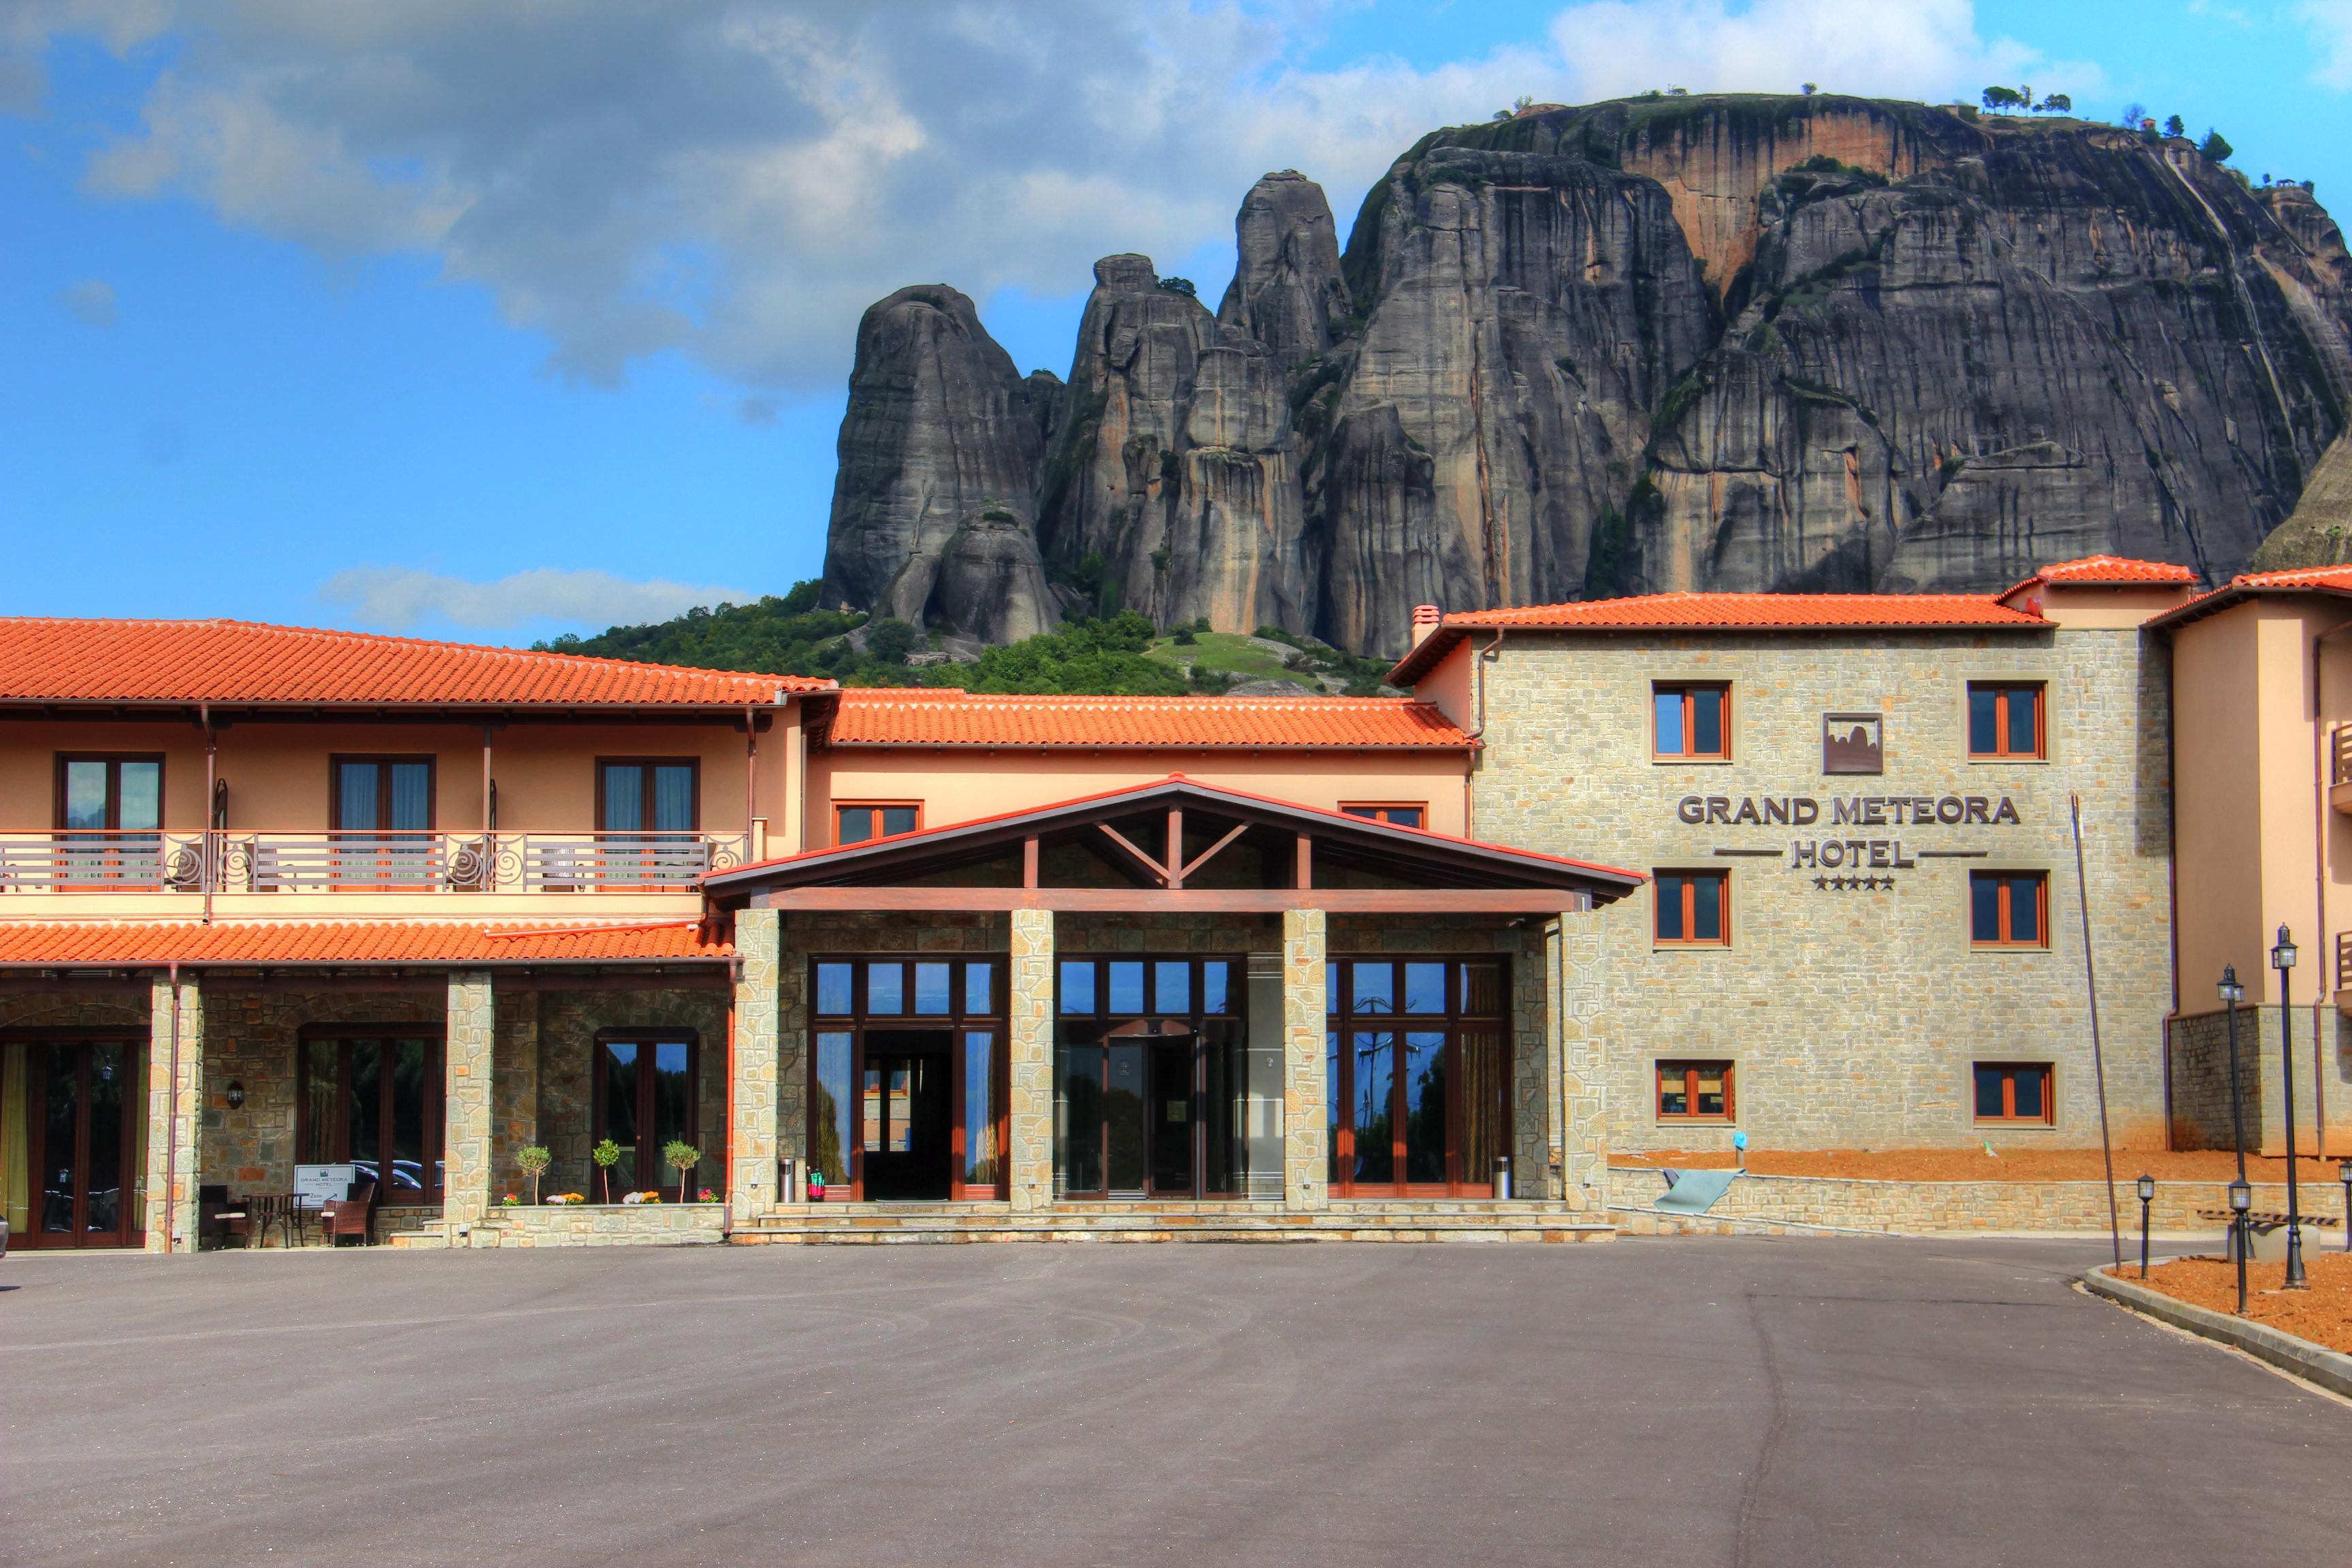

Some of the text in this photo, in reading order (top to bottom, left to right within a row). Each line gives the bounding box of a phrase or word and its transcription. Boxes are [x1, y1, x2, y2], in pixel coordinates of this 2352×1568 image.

[1678, 796, 2021, 825] GRAND METEORA
[1792, 840, 1914, 868] HOTEL
